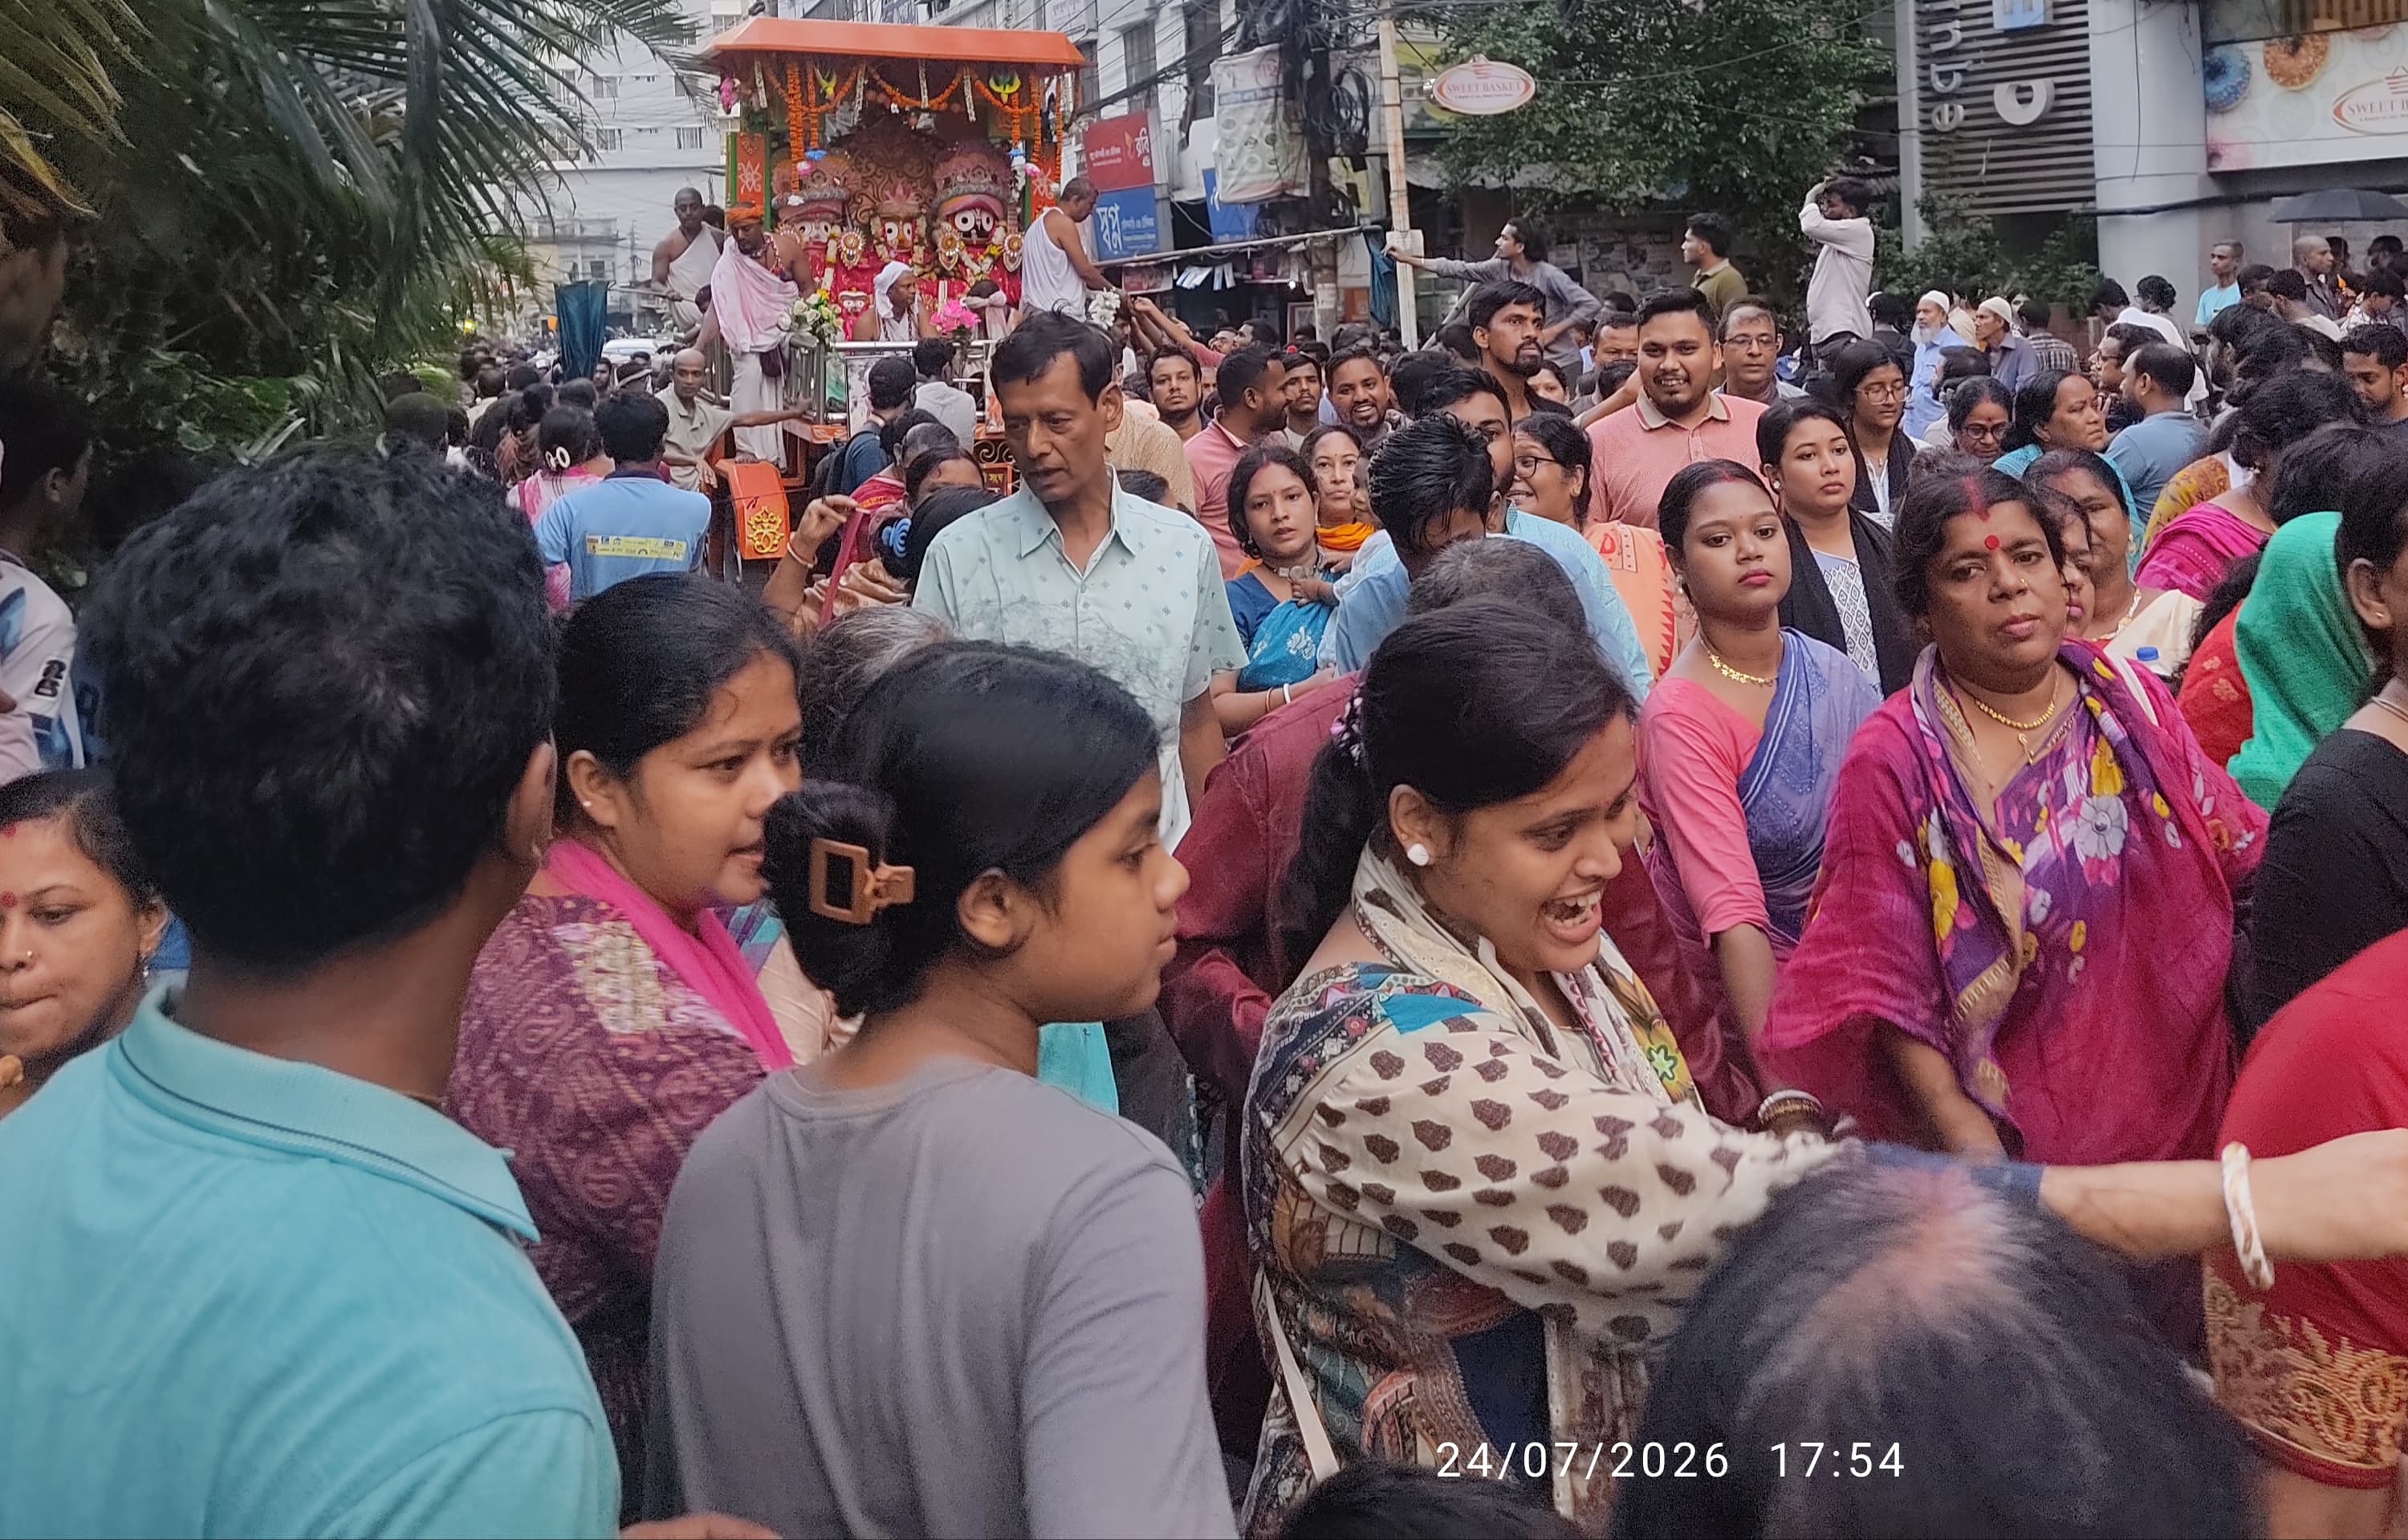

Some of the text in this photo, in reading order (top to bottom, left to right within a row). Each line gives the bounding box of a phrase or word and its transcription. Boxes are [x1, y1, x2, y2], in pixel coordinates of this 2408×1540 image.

[1446, 81, 1522, 94] SWEET BASKET
[2348, 99, 2395, 116] SWEET
